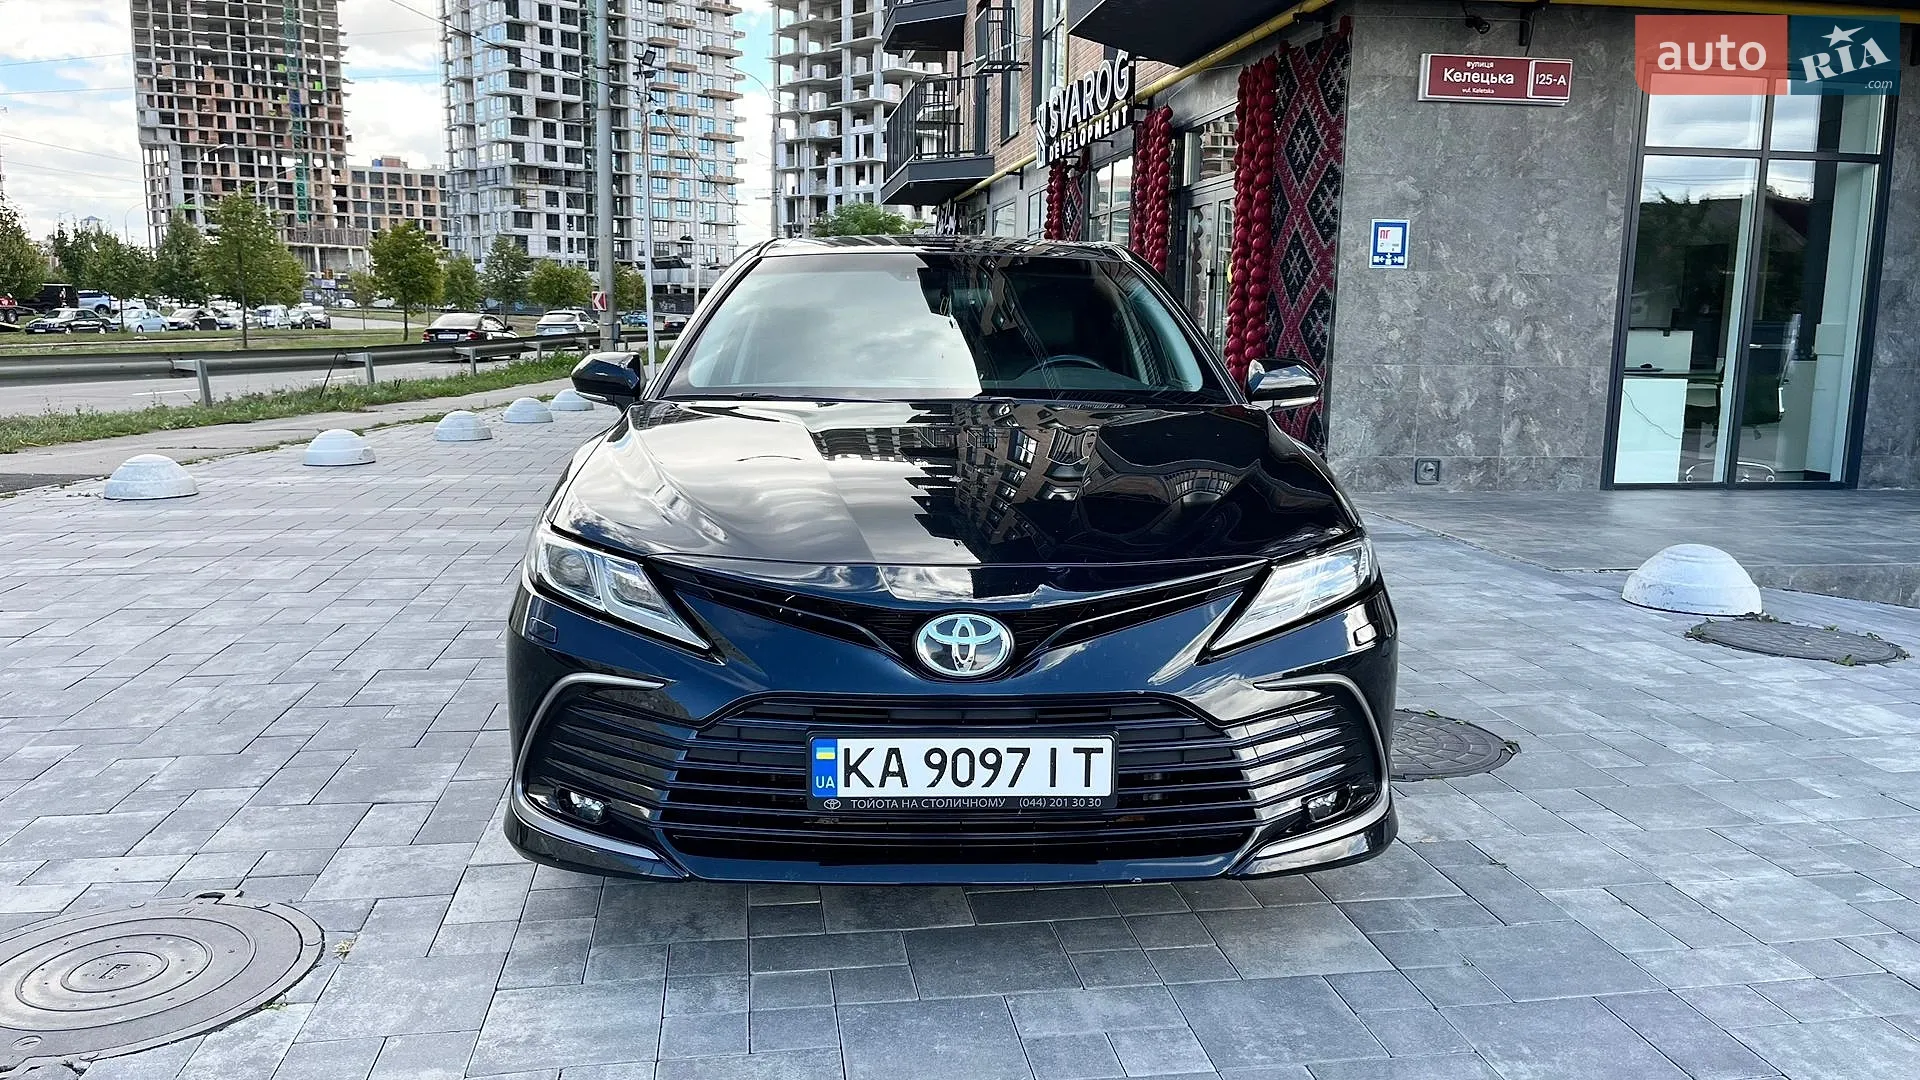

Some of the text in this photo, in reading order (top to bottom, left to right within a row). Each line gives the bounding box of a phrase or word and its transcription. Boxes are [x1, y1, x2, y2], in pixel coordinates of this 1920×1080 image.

[1466, 61, 1494, 69] вулиця
[1443, 67, 1514, 85] Келецька
[1049, 50, 1129, 138] SVAROG
[1049, 105, 1128, 162] DEVELOPMENT
[844, 747, 908, 788] KA
[924, 747, 1031, 788] 9097
[815, 775, 835, 788] UA
[851, 798, 1102, 809] ТОЙОТА НА СТОЛИЧНОМУ (044) 201 30 30
